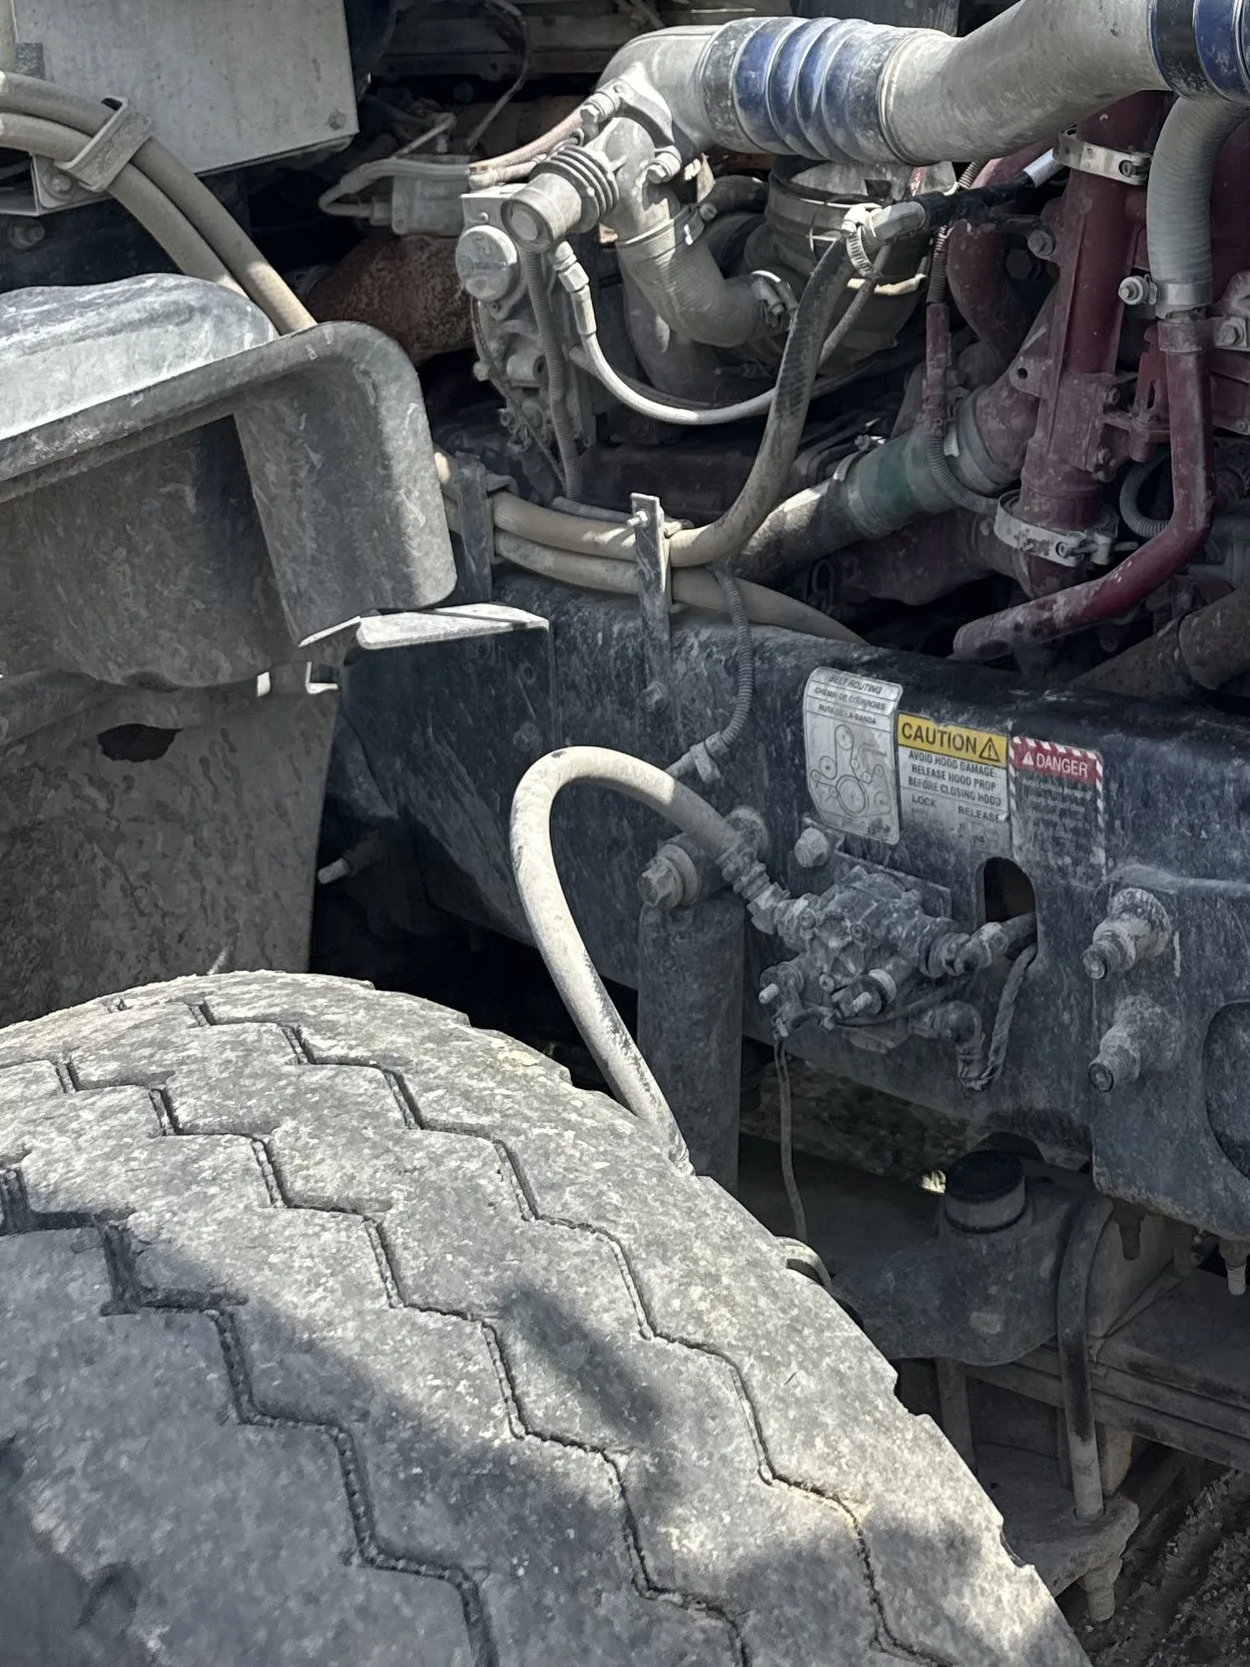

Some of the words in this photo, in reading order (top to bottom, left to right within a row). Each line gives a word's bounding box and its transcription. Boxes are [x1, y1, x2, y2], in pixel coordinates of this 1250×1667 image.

[829, 675, 849, 686] BELT
[848, 679, 883, 695] ROUTING
[901, 722, 977, 755] CAUTION
[908, 750, 933, 764] AVOID
[935, 756, 958, 769] HOOD
[1036, 752, 1088, 779] DANGER
[908, 776, 939, 792] BEFORE
[940, 783, 976, 801] CLOSING
[977, 792, 1002, 807] HOOD
[911, 764, 946, 781] RELEASE
[948, 772, 972, 786] HOOD
[973, 777, 997, 792] PROP
[911, 794, 937, 807] LOCK
